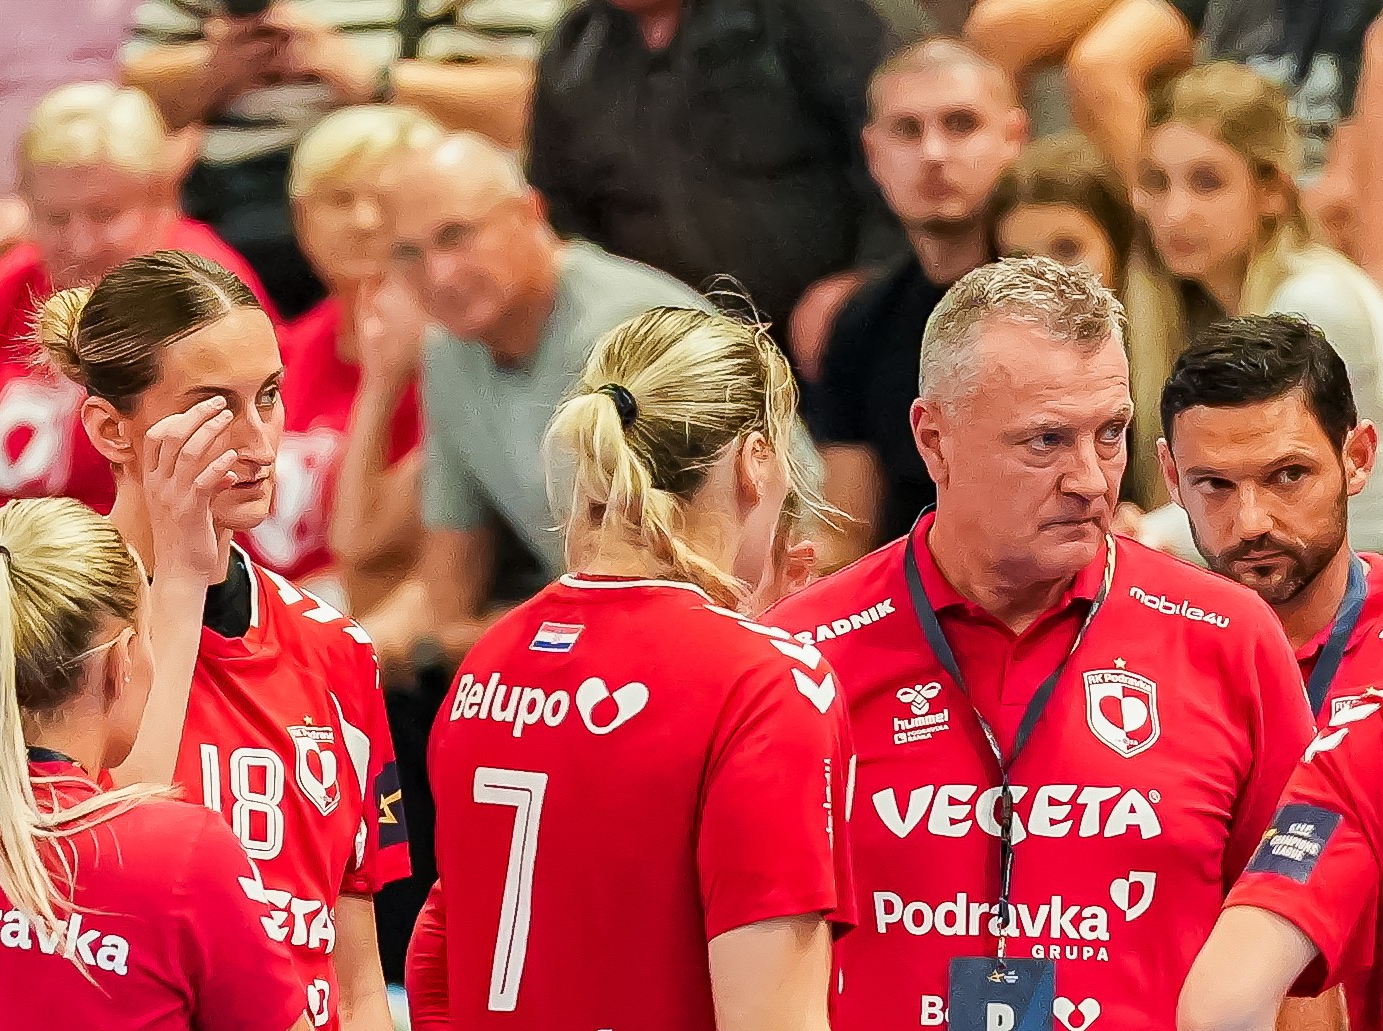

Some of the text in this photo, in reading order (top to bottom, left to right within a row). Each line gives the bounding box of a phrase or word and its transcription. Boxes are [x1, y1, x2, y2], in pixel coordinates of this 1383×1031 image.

[794, 598, 896, 645] RADNIK
[1129, 586, 1230, 628] mobile4u
[449, 672, 570, 737] Belupo
[893, 708, 949, 731] hummel
[200, 743, 285, 860] 18
[872, 783, 1162, 845] VEGETA
[473, 767, 549, 1012] 7
[873, 891, 1110, 941] Podravka
[1031, 944, 1109, 961] GRUPA
